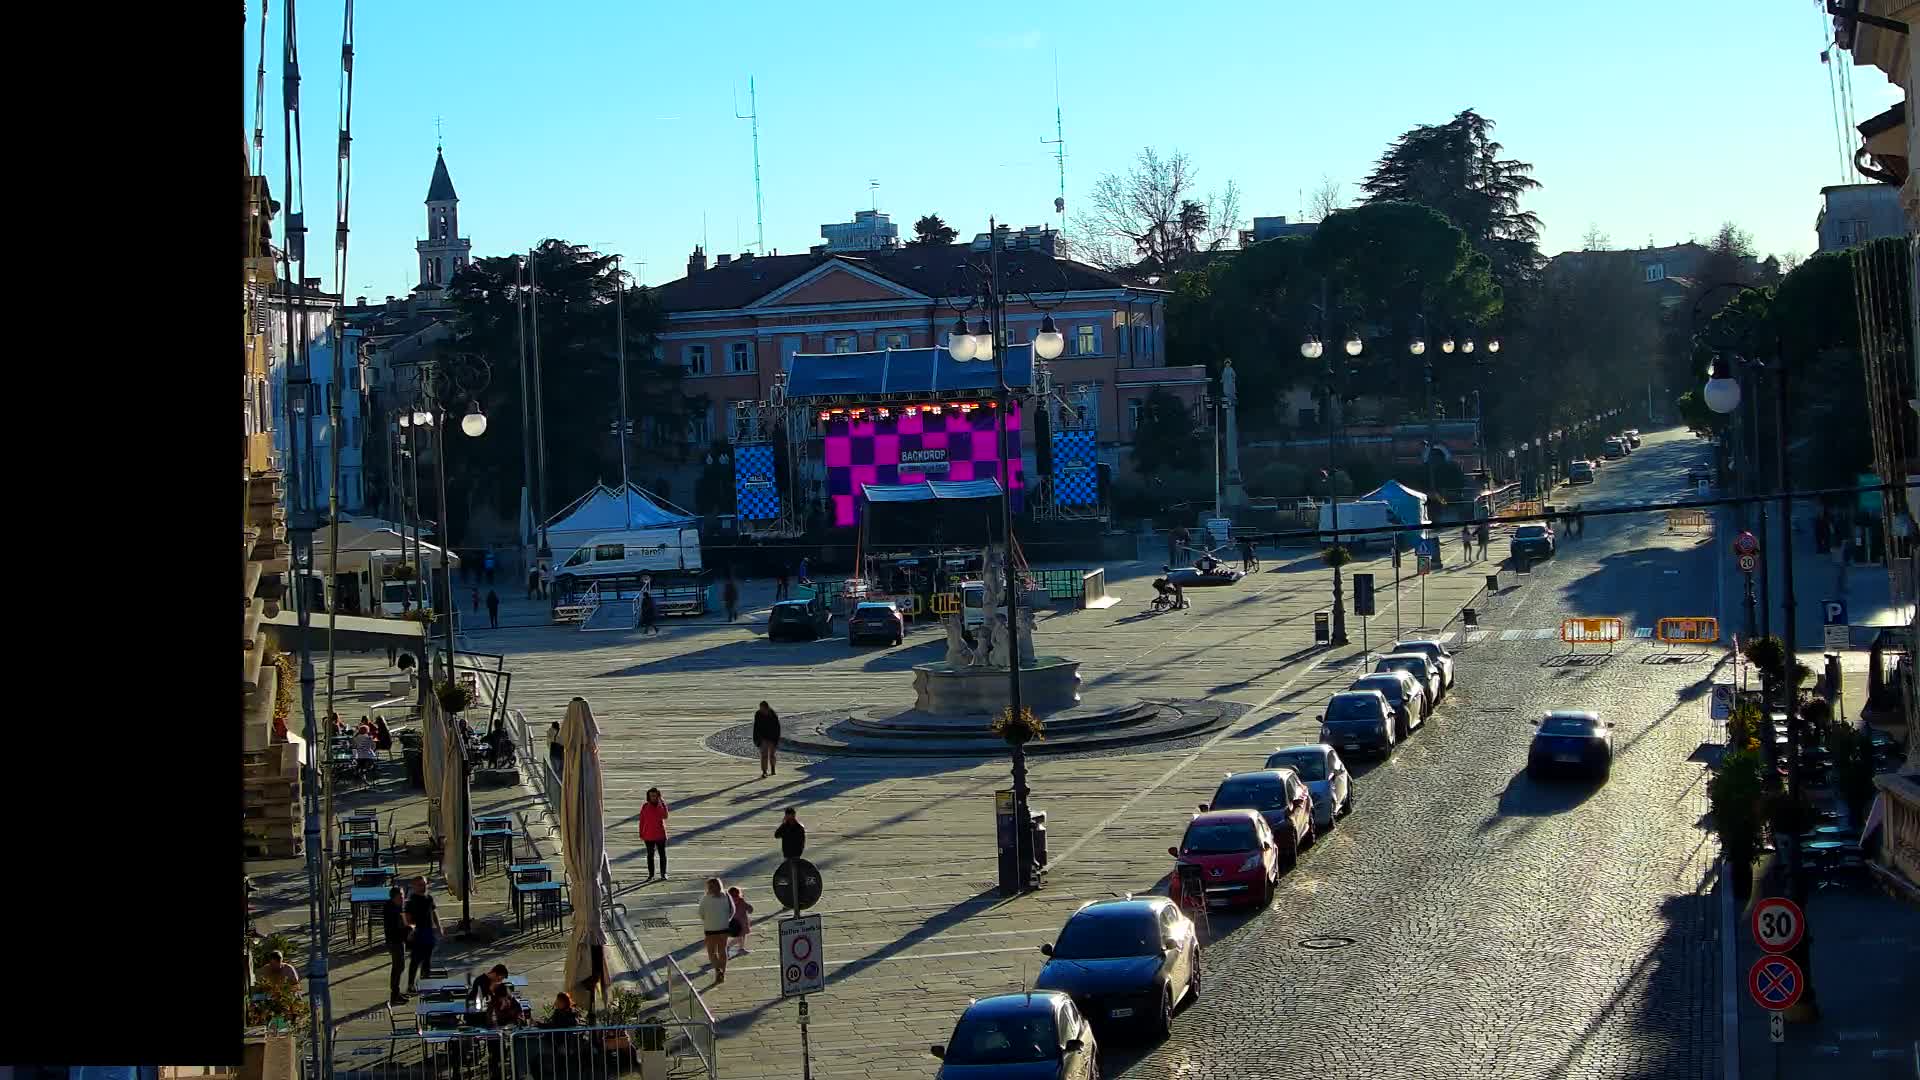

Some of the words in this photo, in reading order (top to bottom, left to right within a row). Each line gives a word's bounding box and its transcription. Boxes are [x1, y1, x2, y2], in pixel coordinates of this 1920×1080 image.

[902, 450, 946, 461] BACKDROP
[1743, 558, 1753, 568] 20
[1828, 603, 1842, 622] P
[1762, 911, 1792, 938] 30
